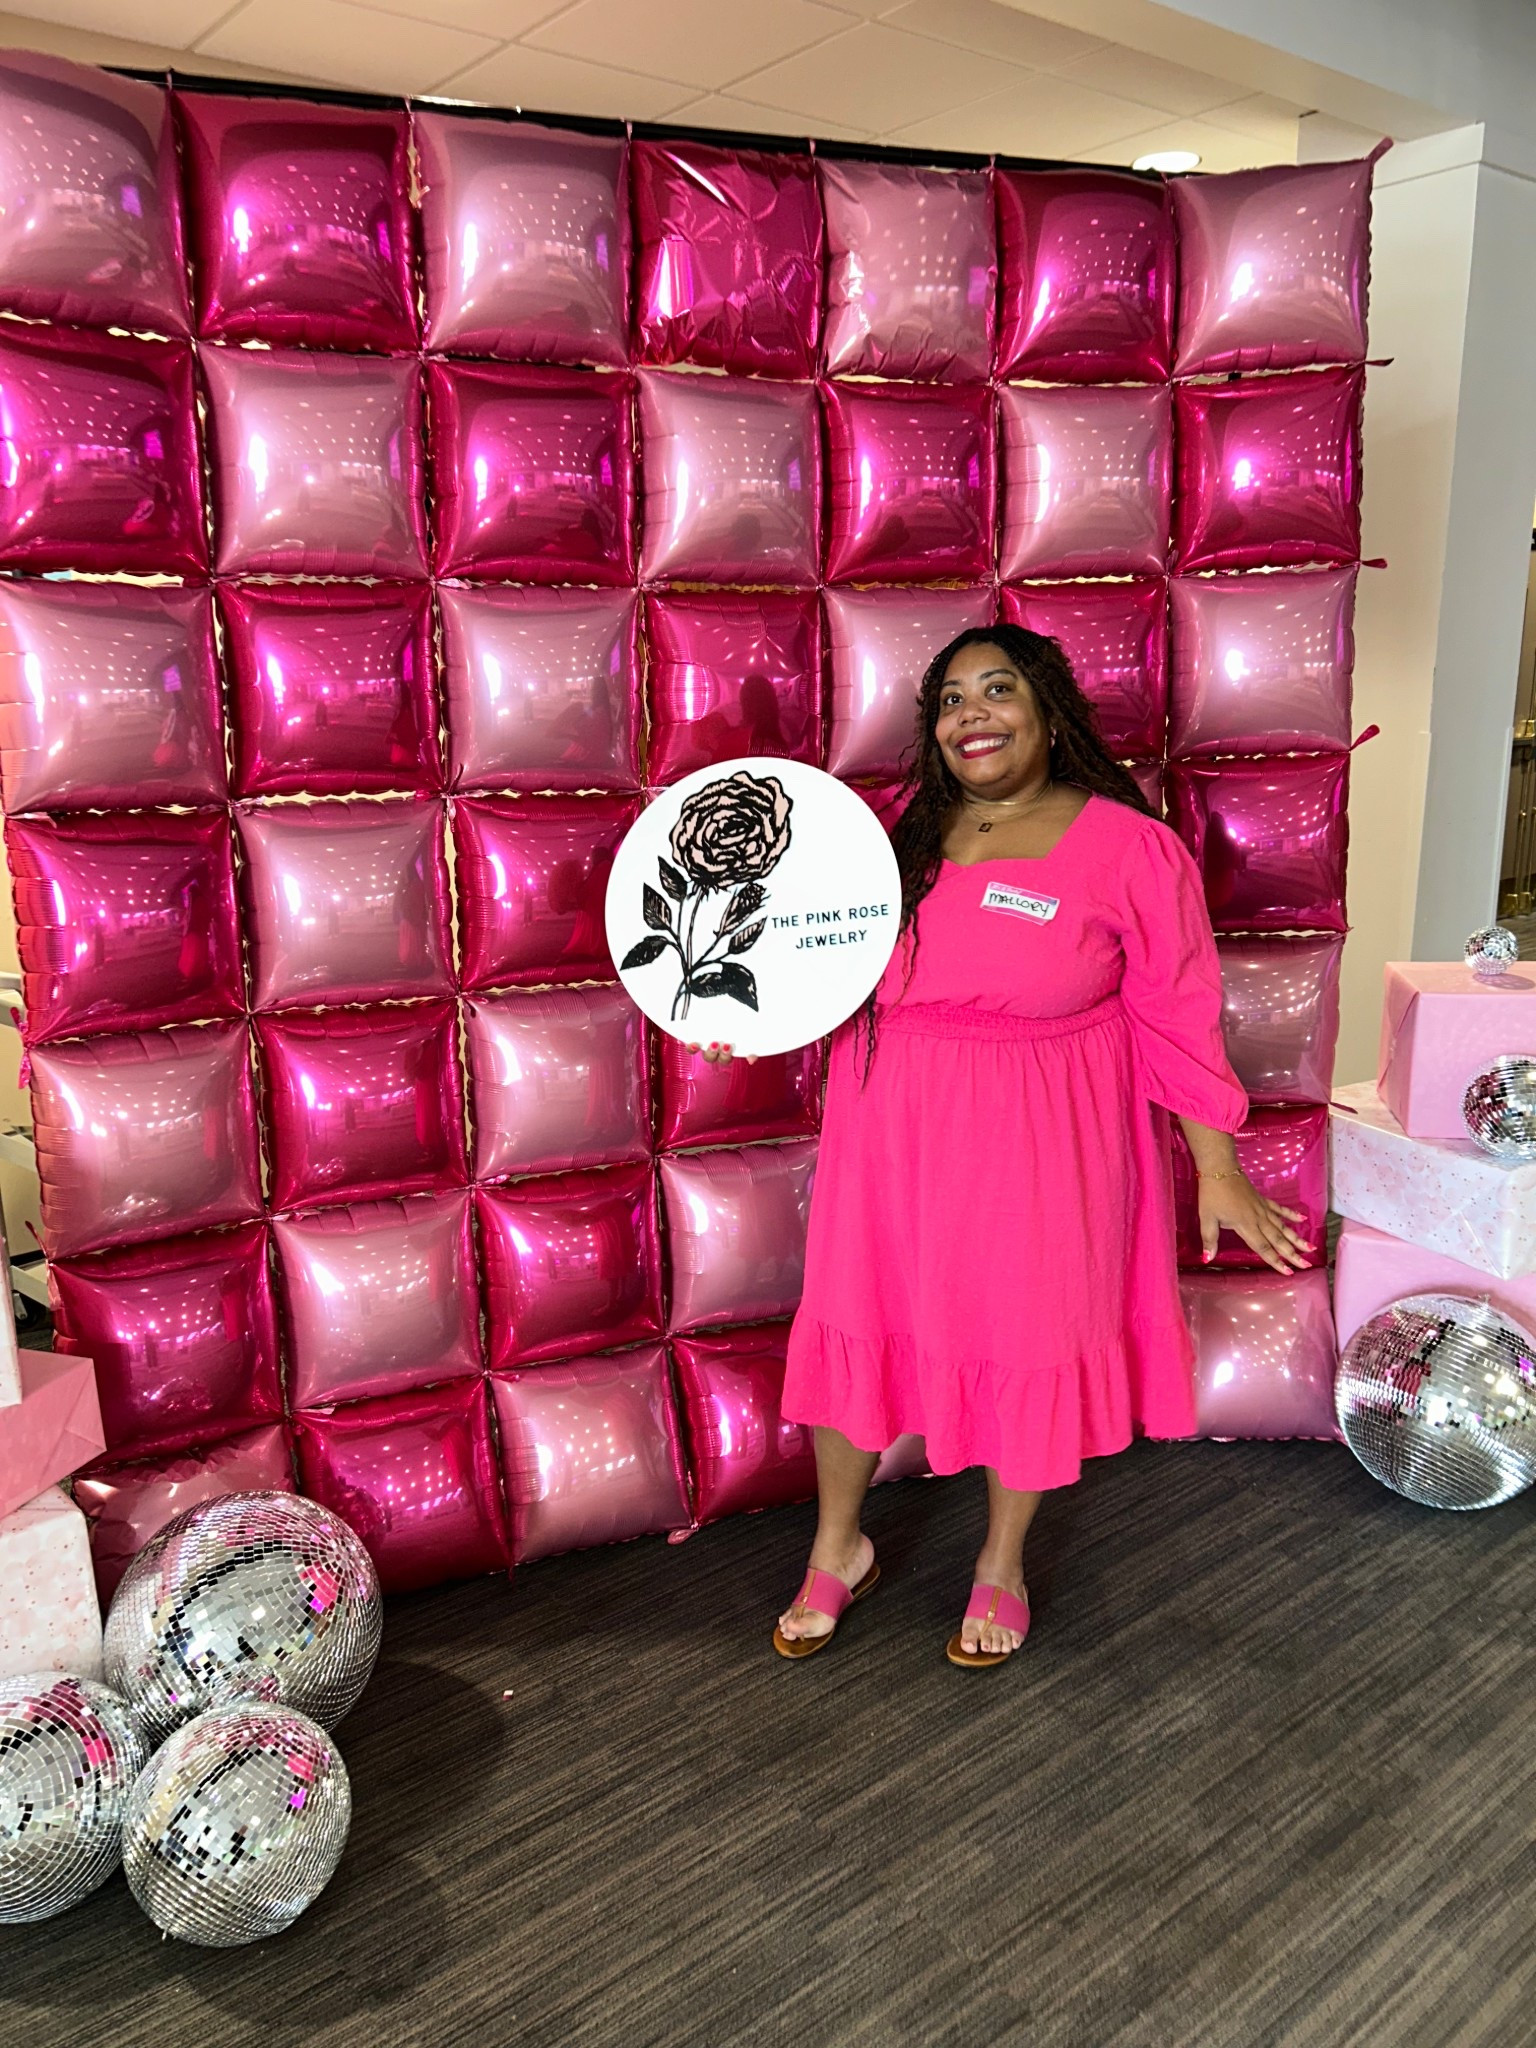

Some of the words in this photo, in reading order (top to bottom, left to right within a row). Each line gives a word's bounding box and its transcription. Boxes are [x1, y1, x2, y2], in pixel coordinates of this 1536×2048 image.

[771, 914, 799, 929] THE
[805, 909, 842, 924] PINK
[848, 903, 889, 920] ROSE
[795, 929, 868, 949] JEWELRY
